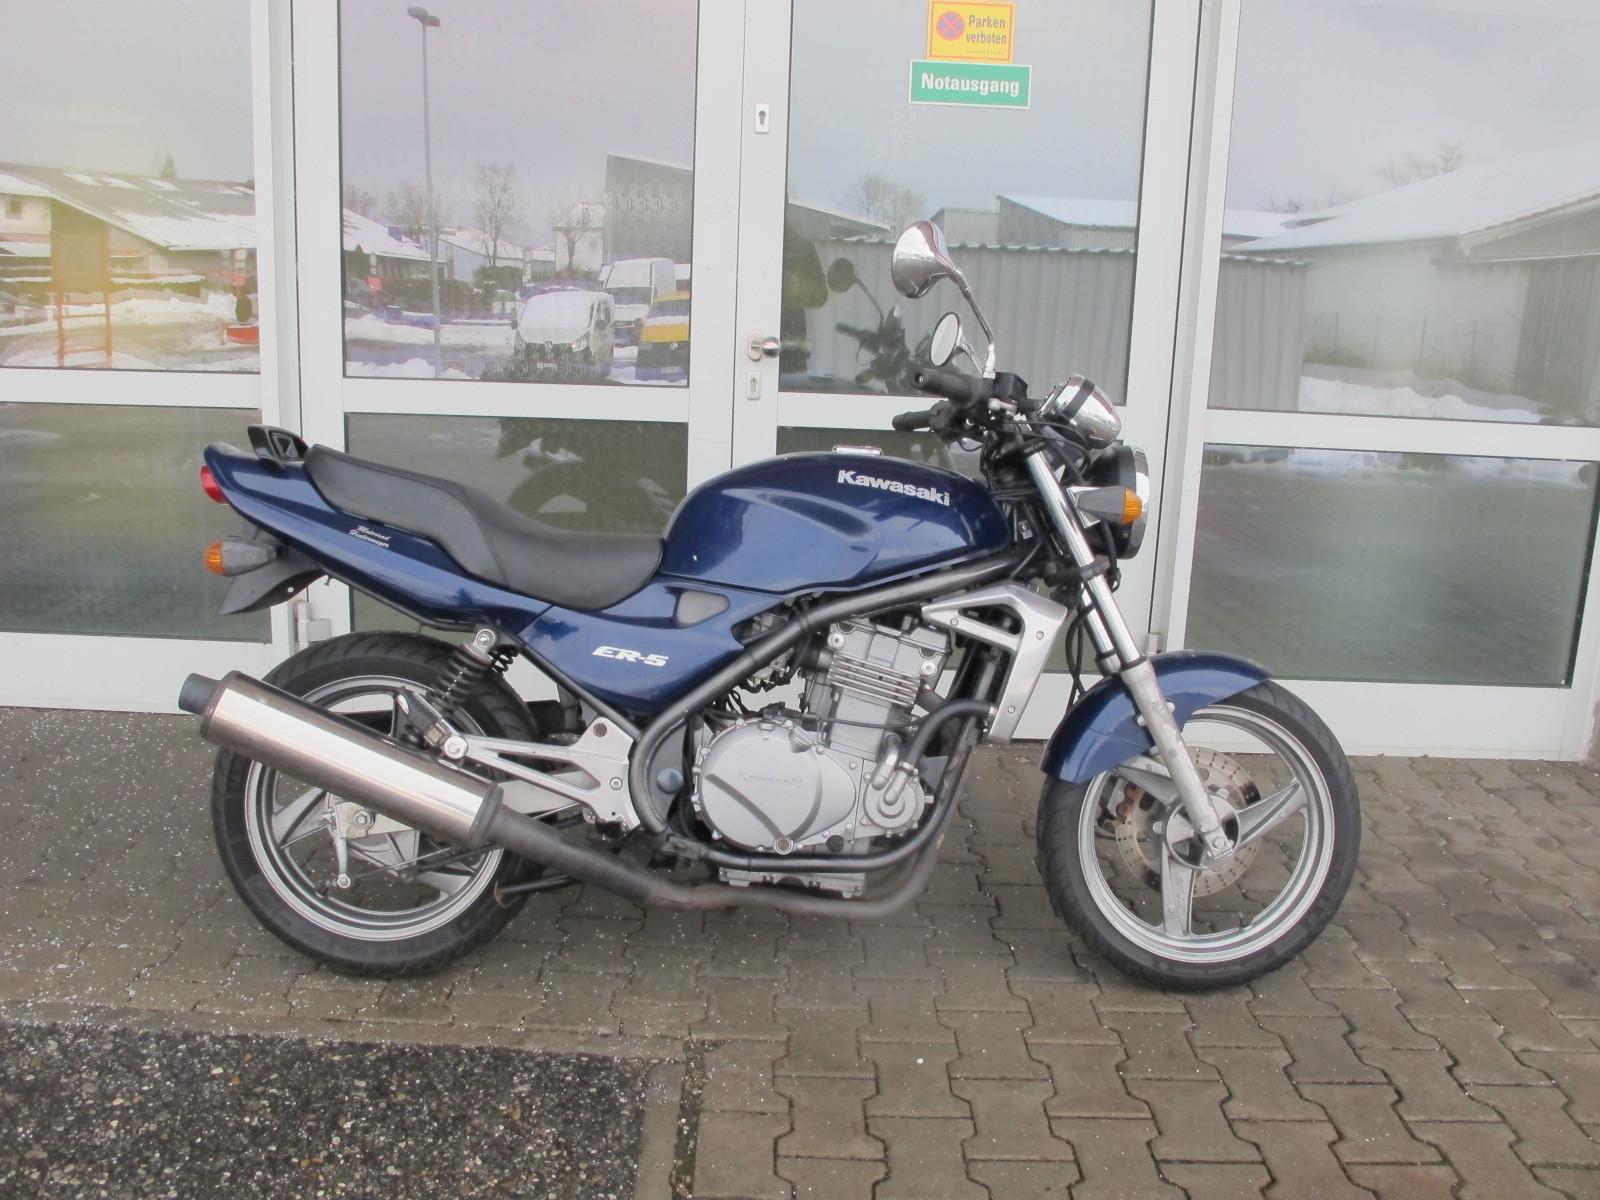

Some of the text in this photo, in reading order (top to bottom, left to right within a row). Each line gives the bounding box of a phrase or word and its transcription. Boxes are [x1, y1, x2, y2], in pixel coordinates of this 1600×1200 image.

[968, 14, 1006, 29] Parken
[966, 31, 1007, 45] verboten
[921, 72, 1020, 98] Notausgang
[837, 469, 950, 506] Kawasaki
